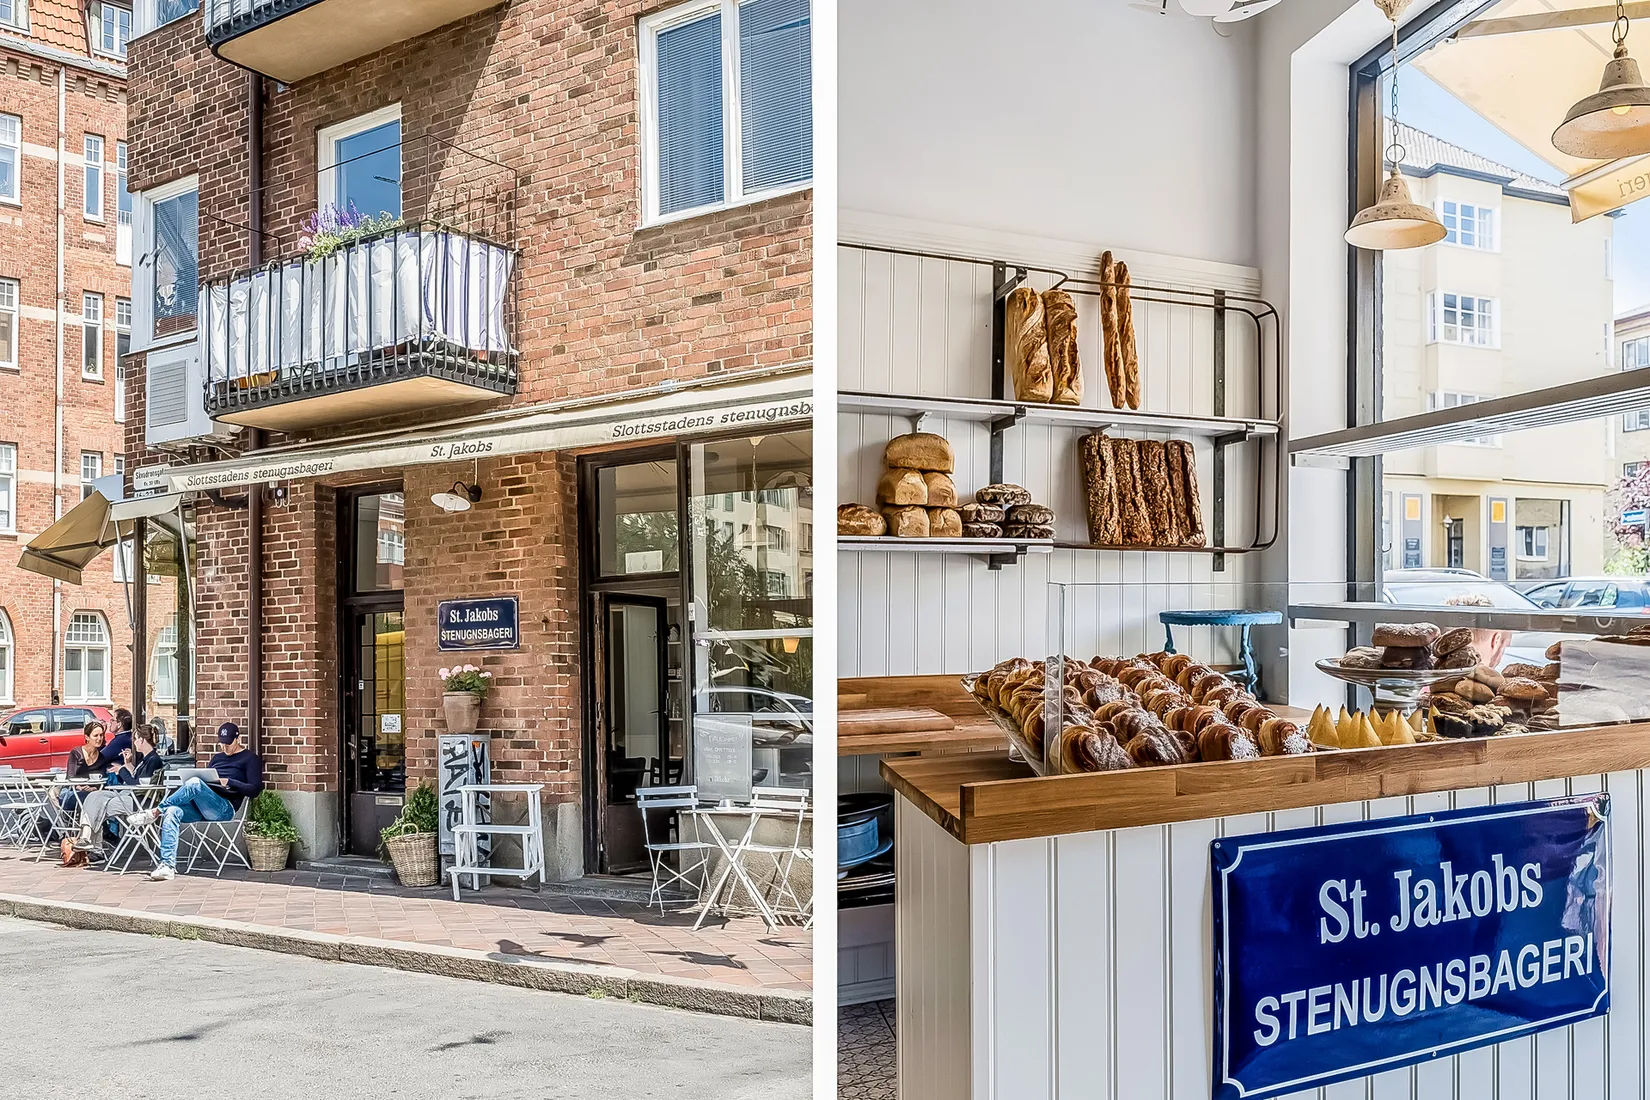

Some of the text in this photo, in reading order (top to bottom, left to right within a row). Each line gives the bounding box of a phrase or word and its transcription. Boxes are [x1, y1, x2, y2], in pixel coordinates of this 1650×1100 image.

[612, 414, 714, 438] Slottsstadens
[430, 440, 493, 459] St. Jakobs
[187, 459, 334, 487] Slottsstadens stenugnsbageri
[449, 607, 499, 623] St. Jakobs
[441, 627, 513, 641] STENUGNSBAGERI
[1318, 853, 1544, 945] St. Jakobs
[1253, 932, 1594, 1047] STENUGNSBAGERI
